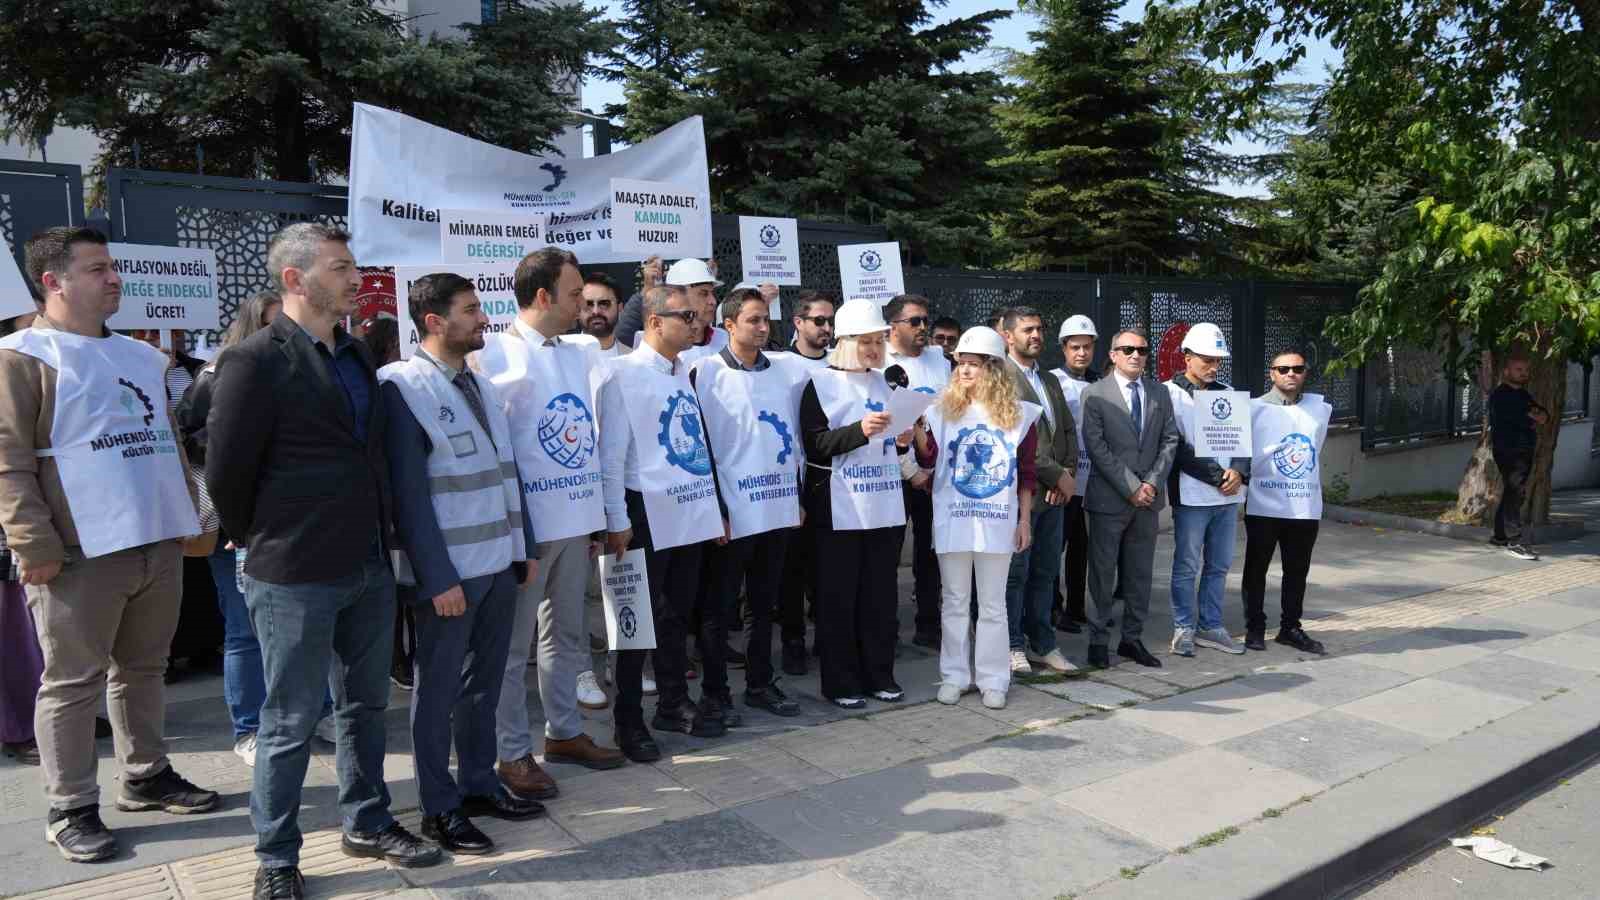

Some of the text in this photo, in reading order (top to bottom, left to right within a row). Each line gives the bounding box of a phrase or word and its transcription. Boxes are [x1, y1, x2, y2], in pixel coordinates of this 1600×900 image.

[615, 191, 699, 210] MAAŞTA ADALET,
[382, 199, 441, 223] Kalitel
[634, 210, 682, 225] KAMUDA
[449, 220, 539, 239] MİMARIN EMEĞİ
[545, 230, 592, 245] değer
[638, 229, 678, 243] HUZUR!
[467, 241, 525, 258] DEĞERSİZ
[180, 259, 212, 278] DEĞİL,
[122, 280, 213, 298] MEĞE ENDEKSLİ
[477, 273, 515, 292] ÖZLÜK
[145, 302, 185, 319] ÜCRET!
[90, 428, 157, 451] MÜHENDİS
[121, 445, 155, 459] KÜLTÜR
[738, 471, 781, 491] MÜHENDİS
